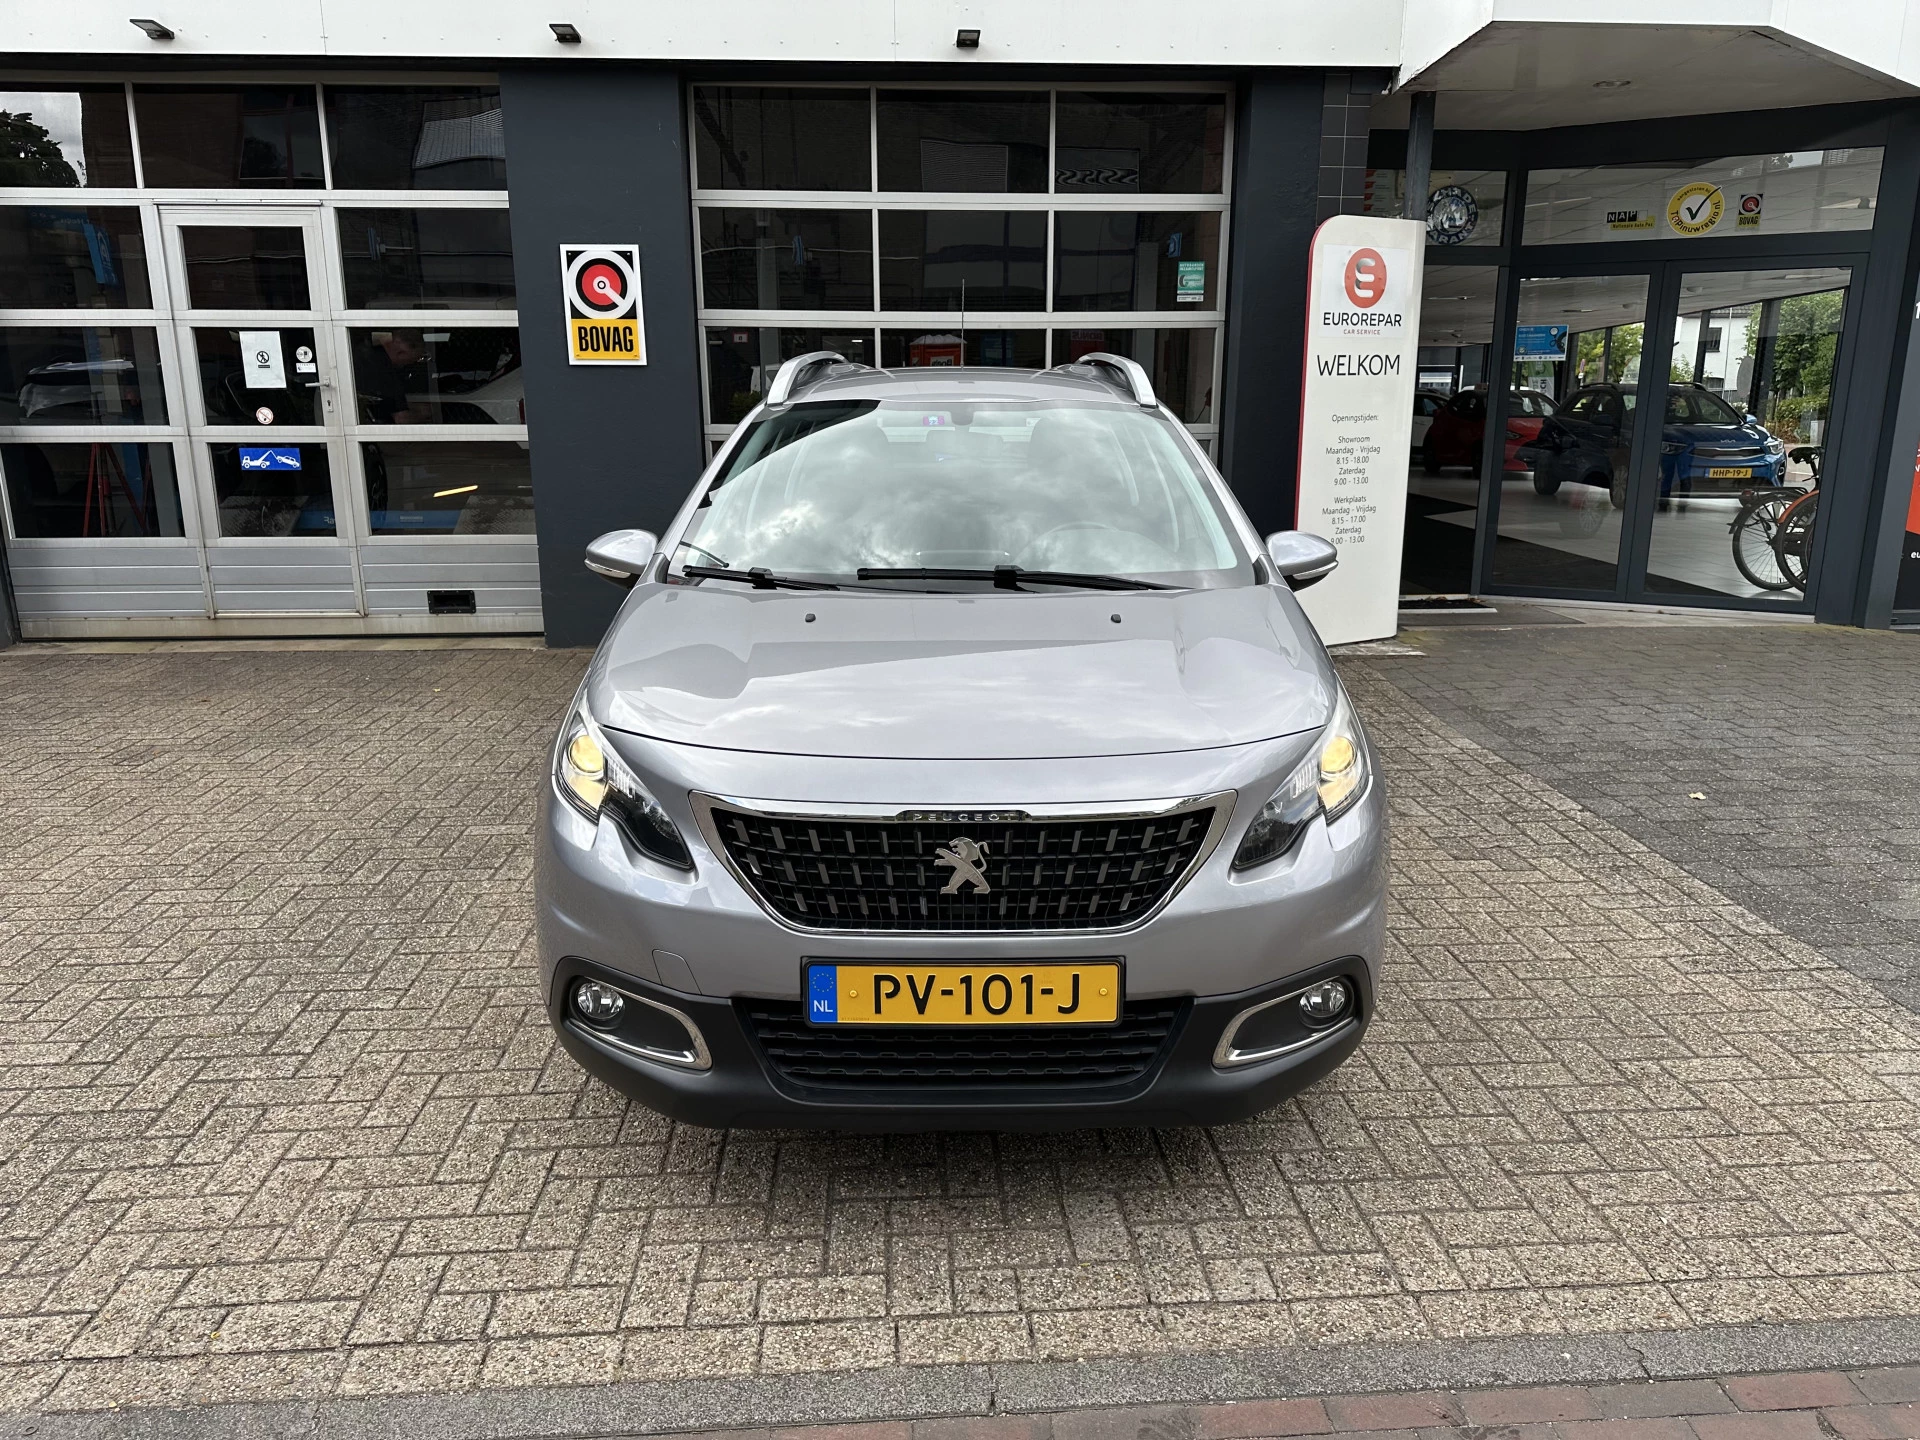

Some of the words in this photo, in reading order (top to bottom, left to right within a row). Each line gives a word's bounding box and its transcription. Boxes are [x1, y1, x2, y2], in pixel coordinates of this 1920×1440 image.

[1608, 210, 1637, 221] NAP
[1738, 216, 1759, 226] BOVAG
[1323, 312, 1402, 327] EUROREPAR
[1357, 328, 1381, 336] SERVICE
[578, 325, 634, 352] BOVAG
[1317, 354, 1400, 376] WELKOM
[1338, 435, 1370, 443] Showroom
[1326, 446, 1354, 455] Maandag
[1359, 445, 1381, 455] Vrijdag
[1336, 457, 1349, 465] 8.15
[1338, 467, 1366, 476] Zaterdag
[1712, 469, 1748, 477] HHP-19-J
[1334, 478, 1347, 486] 9.00
[1353, 476, 1369, 485] 13.00
[1334, 495, 1367, 505] Werkplaats
[1322, 506, 1350, 516] Maandag
[1355, 504, 1377, 514] Vrijdag
[1331, 517, 1344, 525] 8.15
[1350, 515, 1367, 523] 17.00
[1335, 526, 1362, 535] Zaterdag
[1349, 535, 1365, 544] 13.00
[912, 813, 1017, 821] PEUGEOT
[873, 972, 1081, 1015] PV-101-J
[813, 1000, 833, 1013] NL
